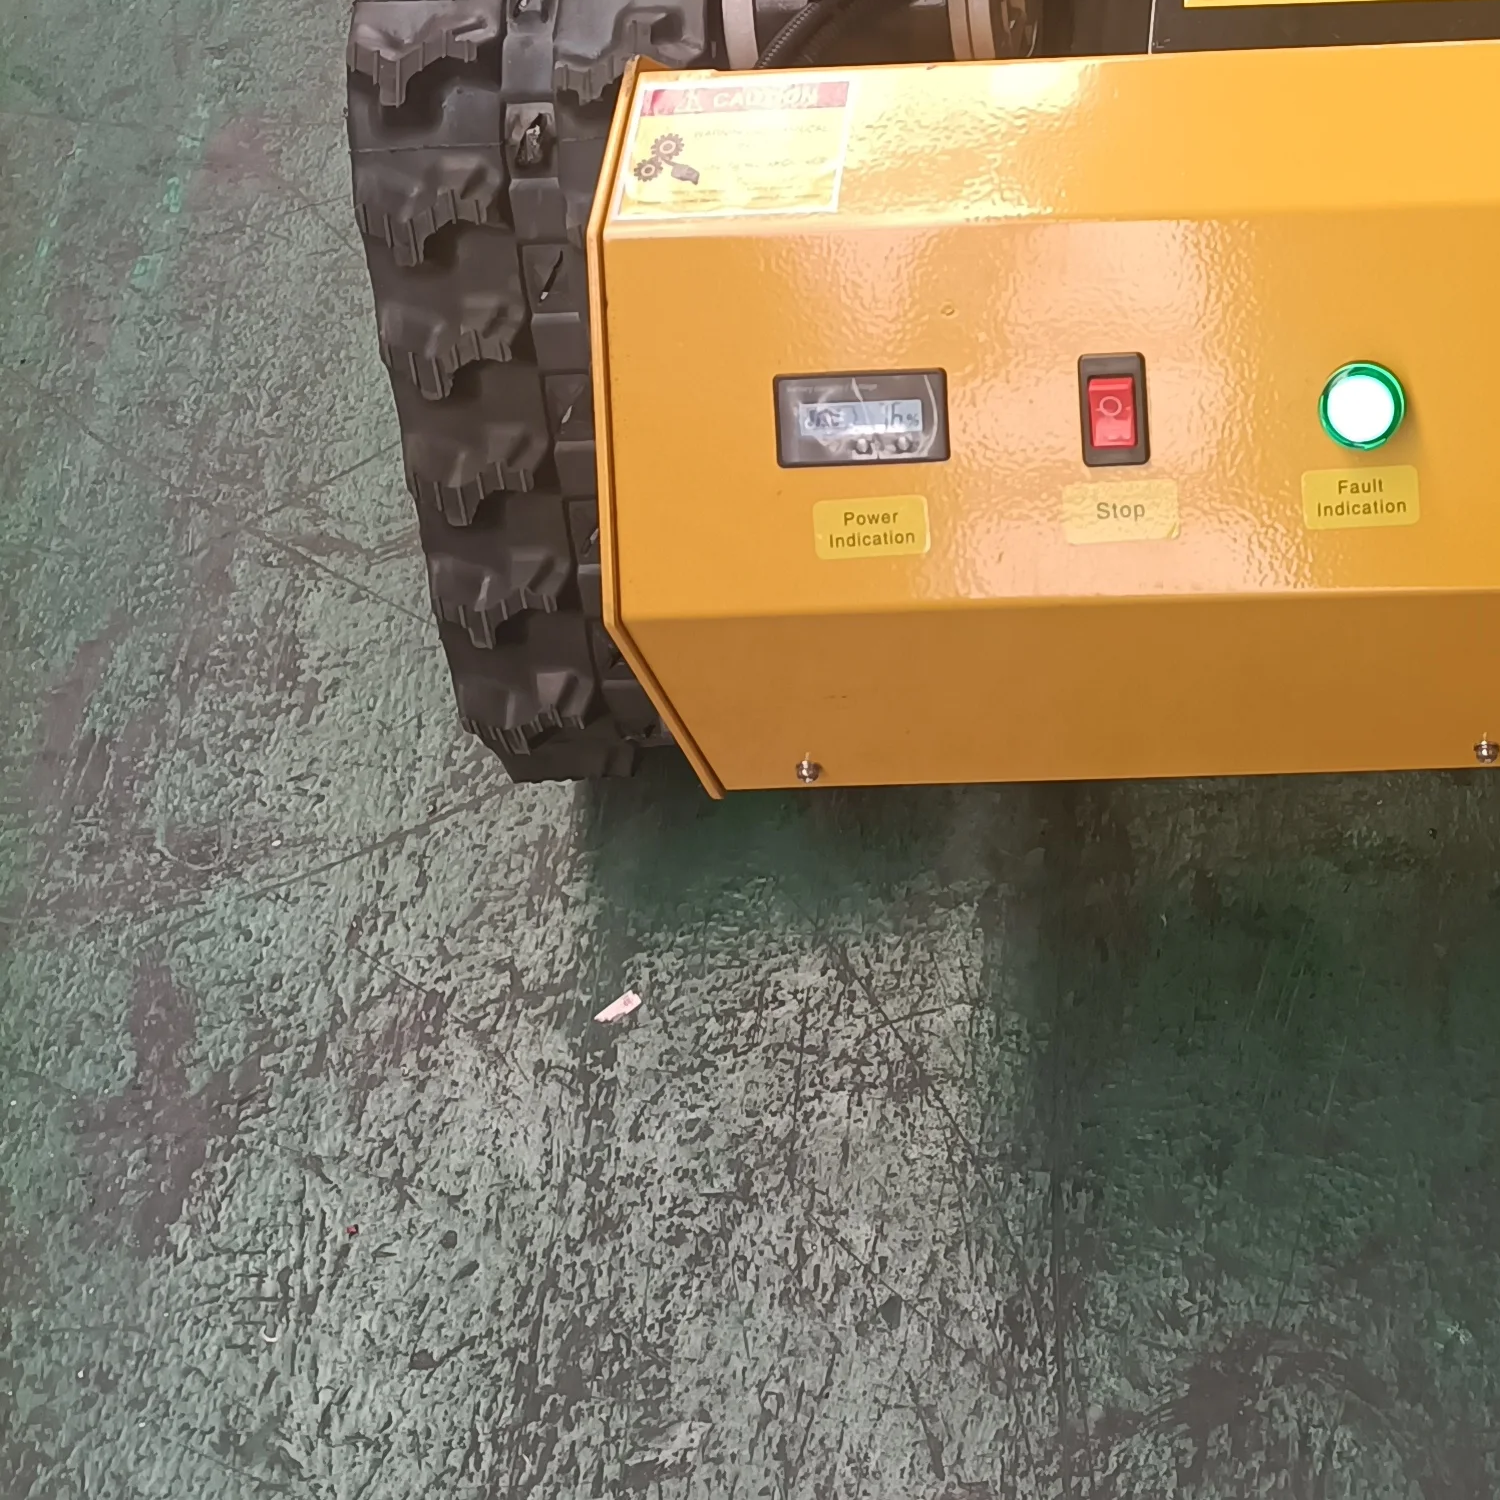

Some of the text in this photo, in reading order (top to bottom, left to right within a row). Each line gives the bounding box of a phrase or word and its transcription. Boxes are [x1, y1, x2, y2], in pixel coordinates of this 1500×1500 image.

[713, 84, 819, 108] CAUON
[1337, 478, 1385, 495] Fault
[1096, 501, 1146, 523] Stop
[1317, 497, 1407, 518] Indication
[843, 509, 899, 527] Power
[829, 529, 916, 549] Indication
